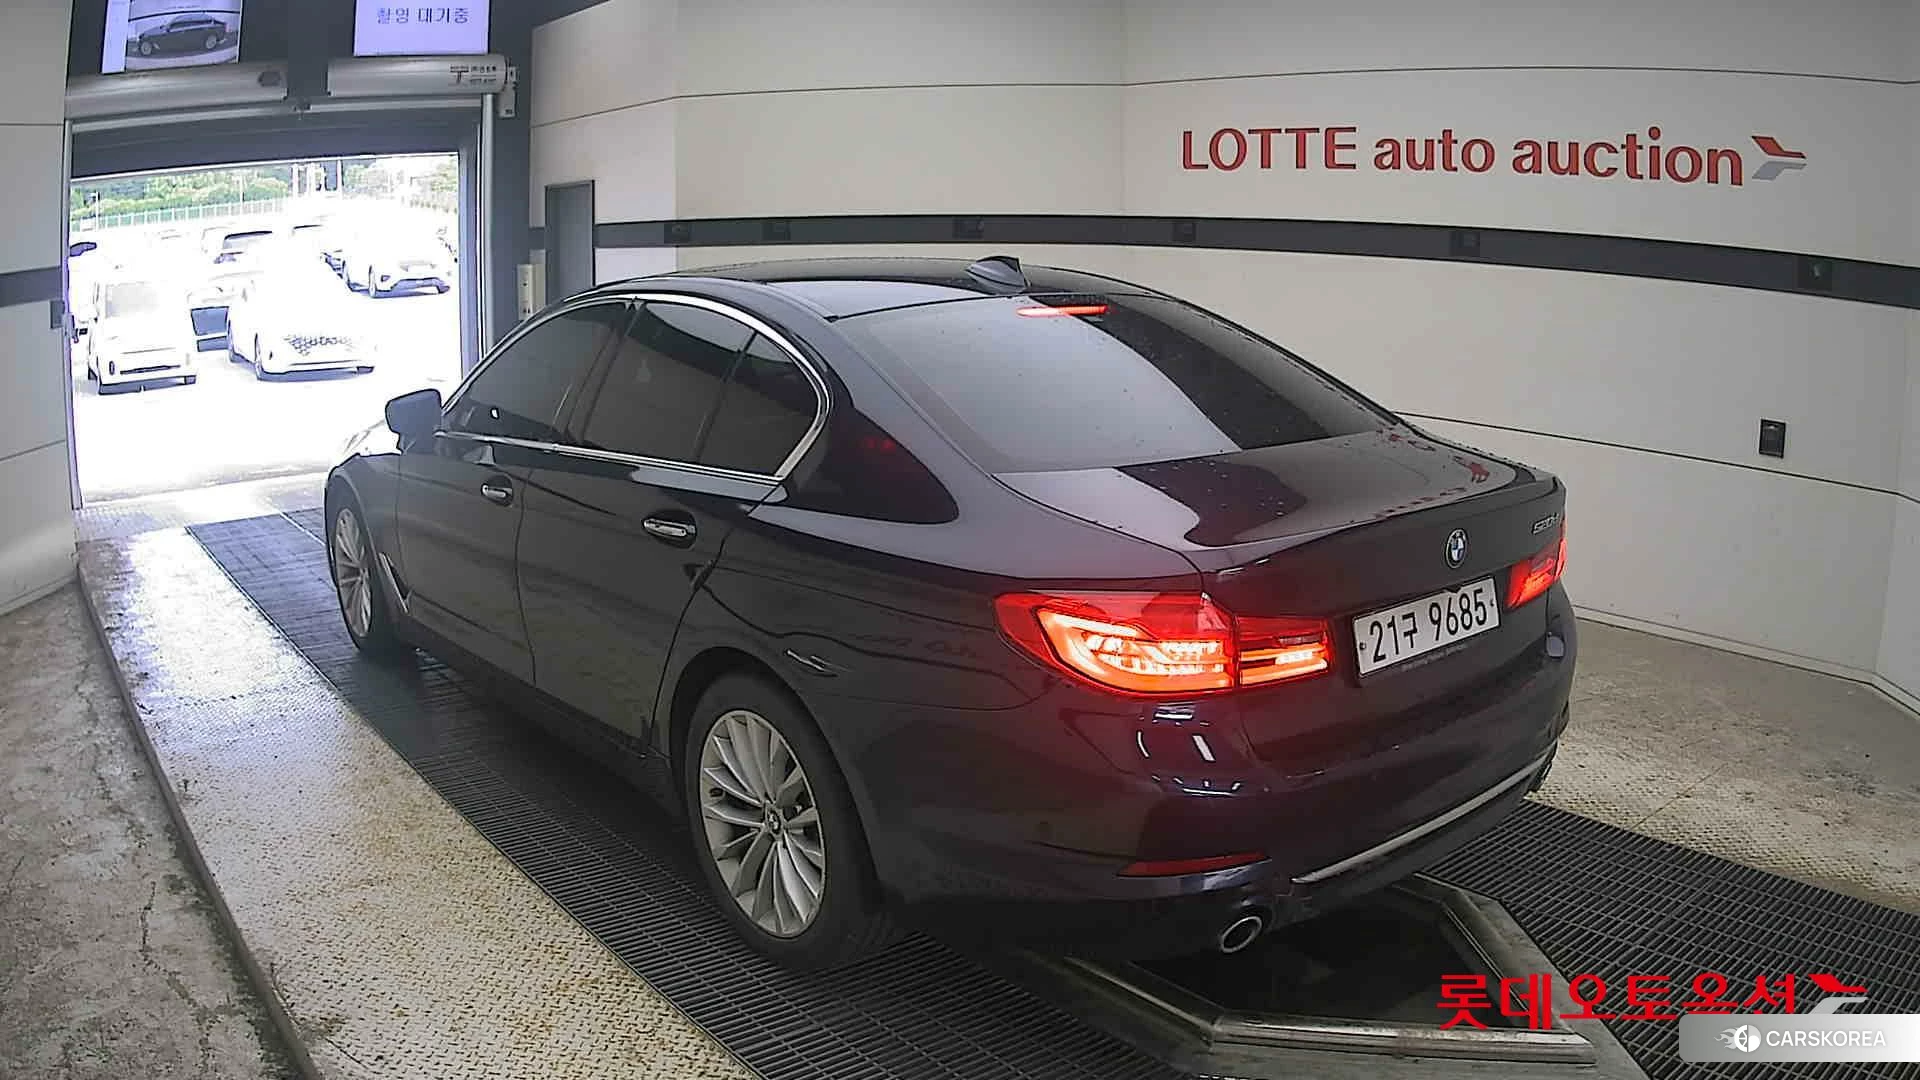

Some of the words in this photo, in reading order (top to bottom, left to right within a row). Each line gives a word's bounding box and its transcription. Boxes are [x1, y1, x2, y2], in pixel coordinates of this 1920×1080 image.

[417, 8, 469, 24] 대기중
[1182, 127, 1358, 171] LOTTE
[1373, 128, 1496, 173] auto
[1511, 127, 1744, 187] auction
[1369, 612, 1418, 663] 21구
[1428, 588, 1488, 642] 9685
